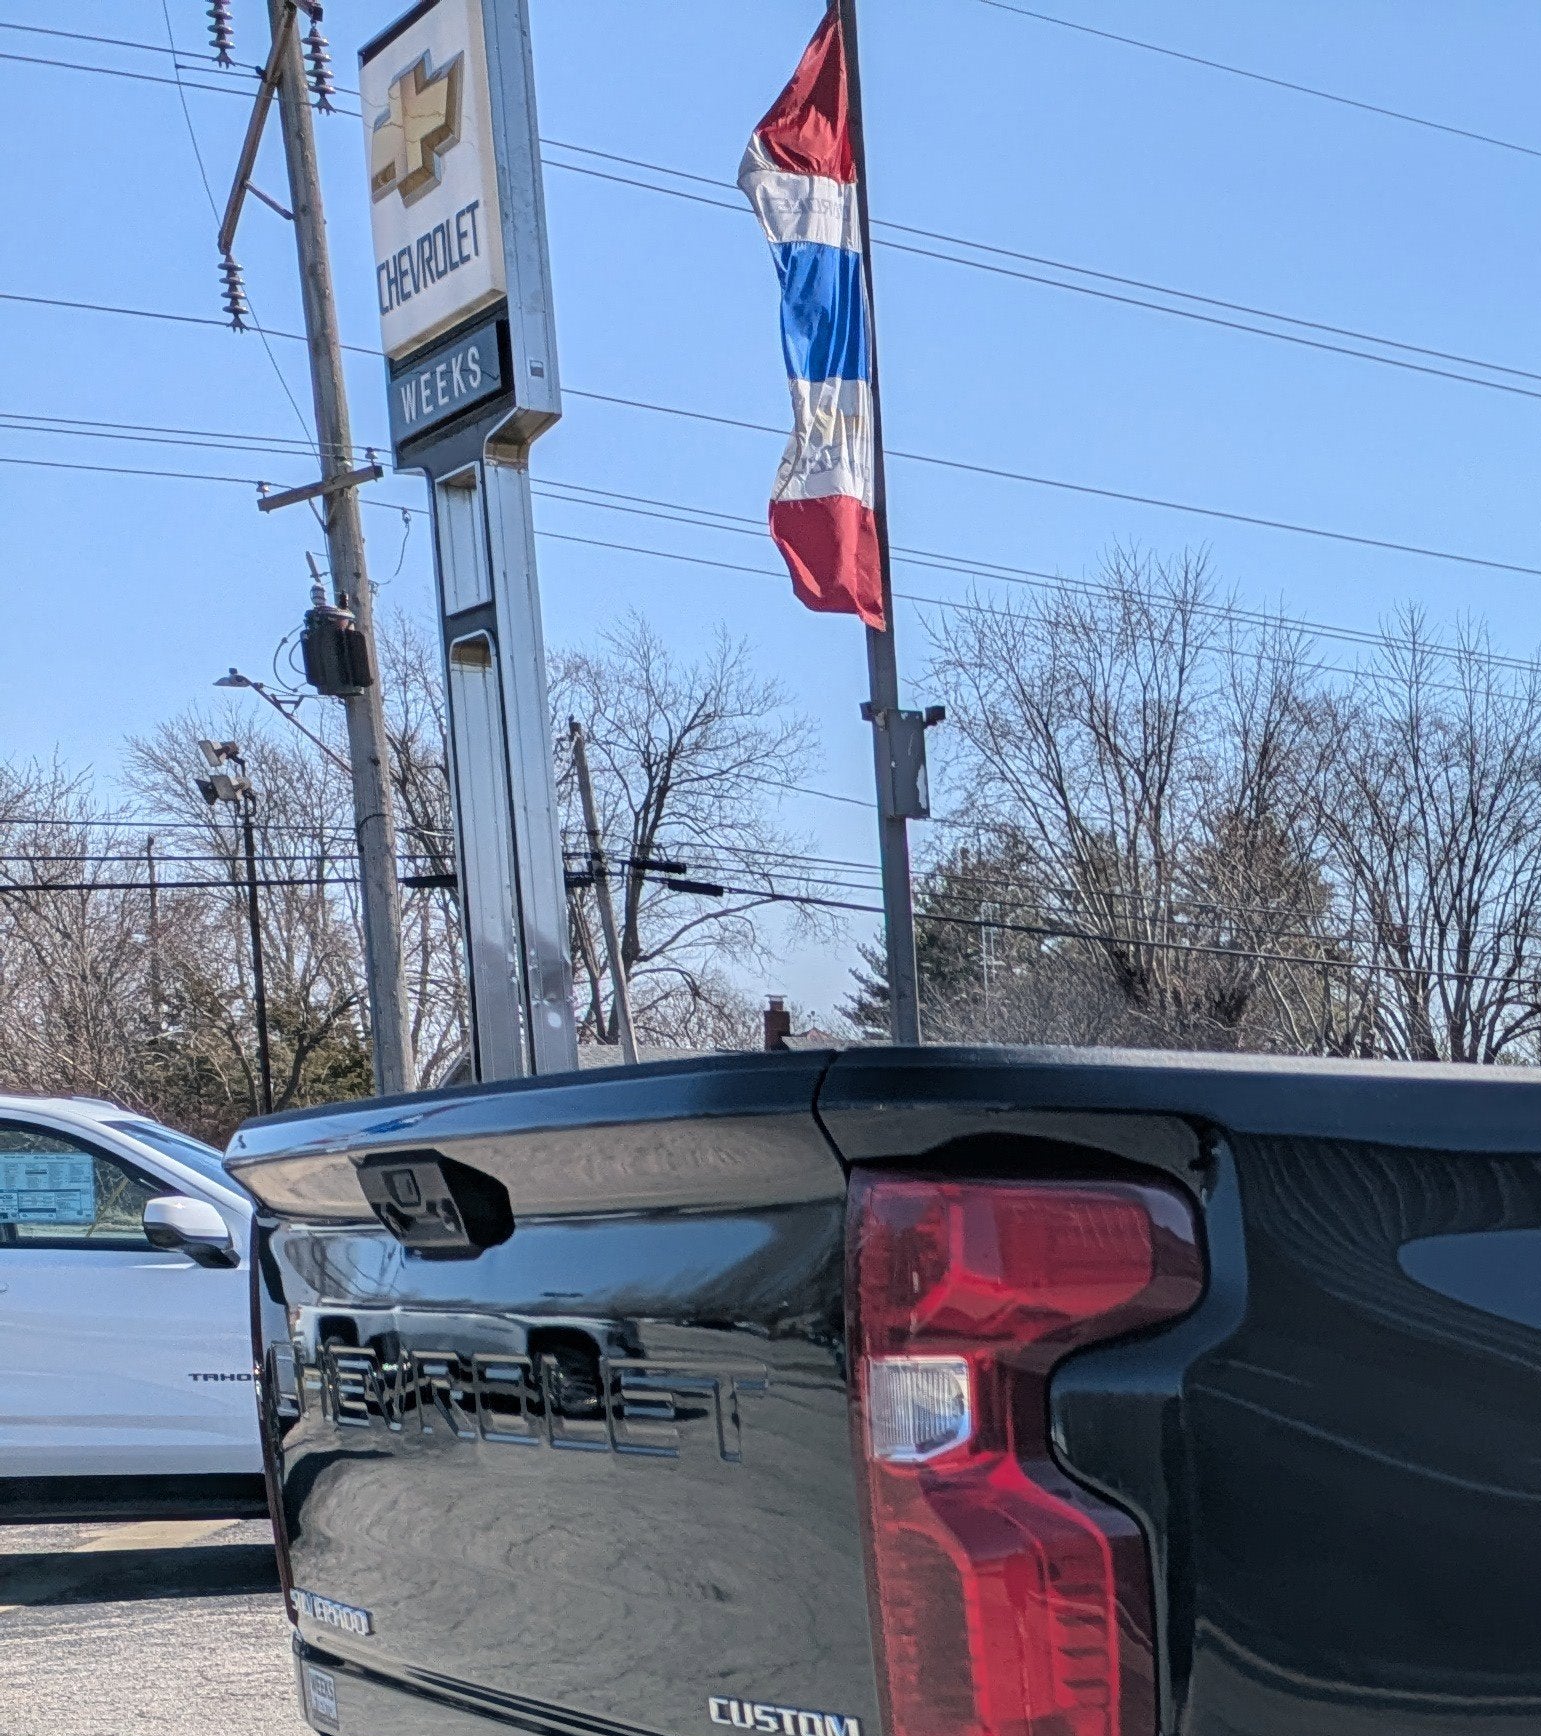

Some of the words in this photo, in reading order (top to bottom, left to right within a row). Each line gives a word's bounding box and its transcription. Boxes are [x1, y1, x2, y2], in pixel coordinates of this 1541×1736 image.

[376, 200, 479, 315] CHEVROLET
[400, 345, 483, 425] WEEKS
[188, 1373, 252, 1382] TAHO
[268, 1341, 768, 1463] CHEVROLET
